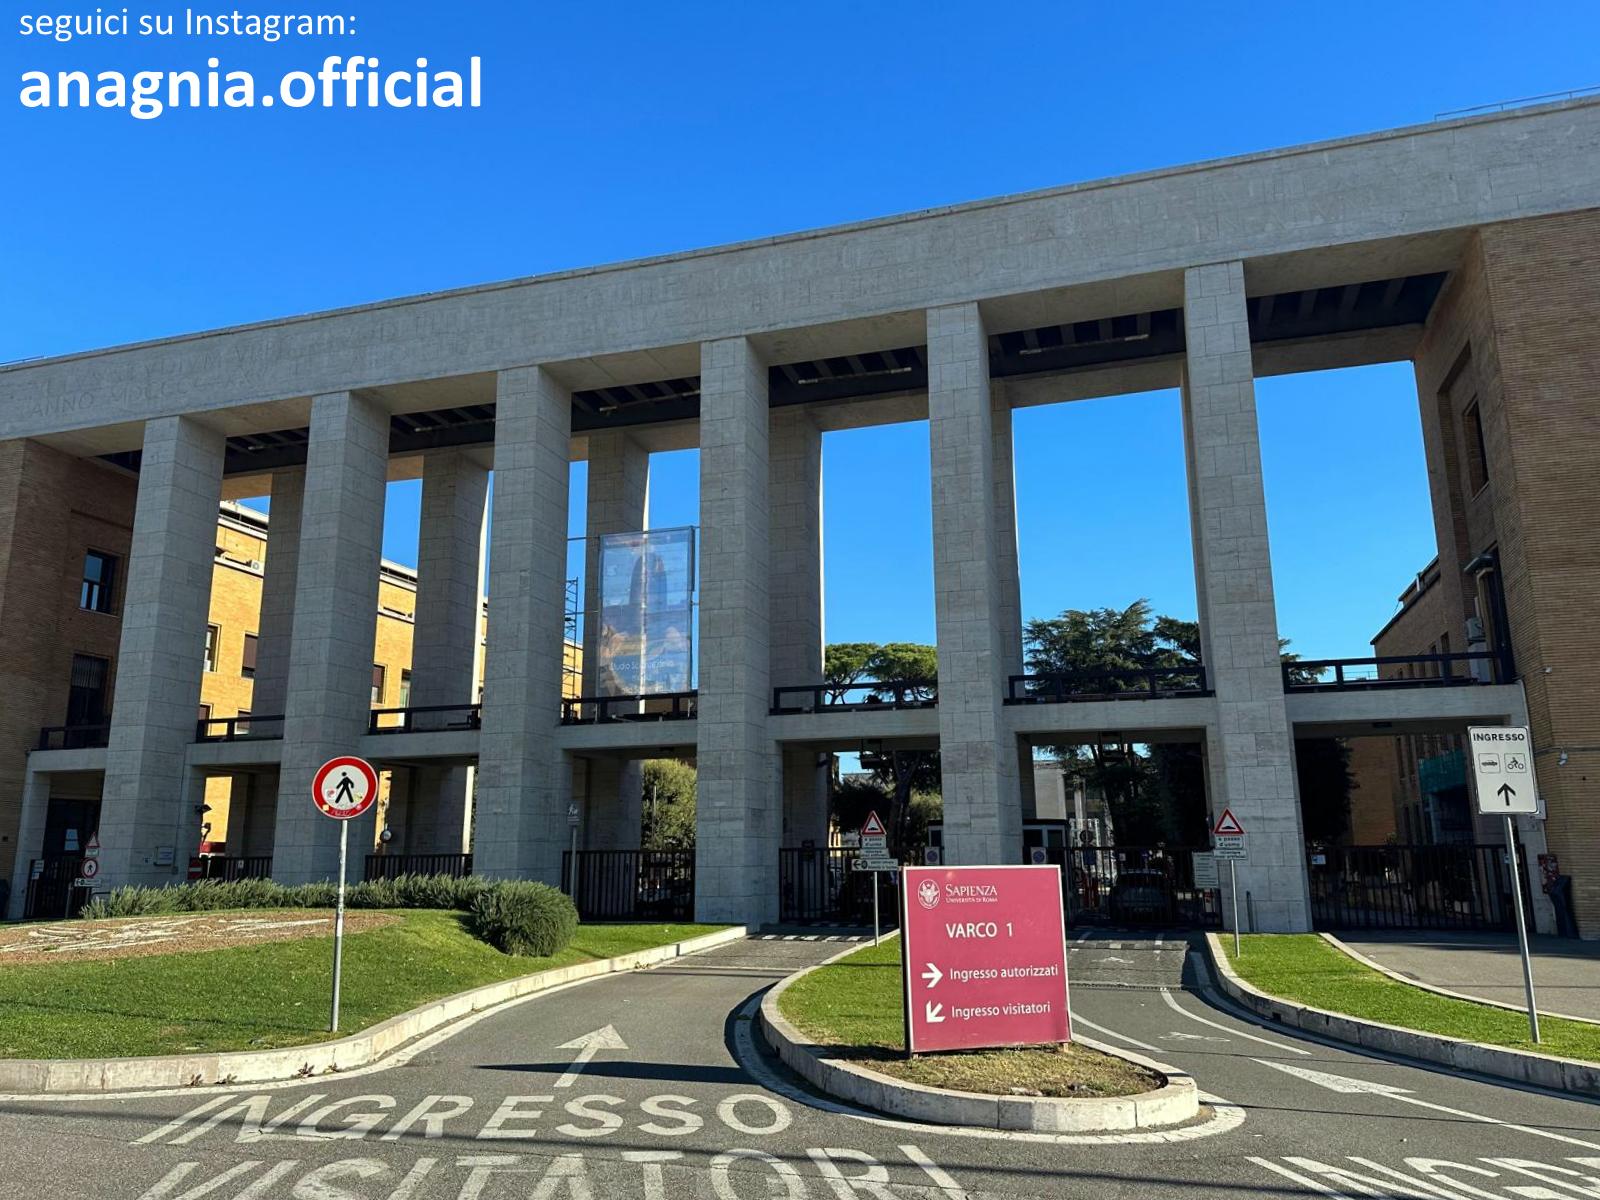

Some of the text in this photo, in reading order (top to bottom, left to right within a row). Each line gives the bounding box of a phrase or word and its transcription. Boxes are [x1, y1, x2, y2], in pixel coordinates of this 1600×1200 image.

[1473, 733, 1525, 741] INGRESSO
[945, 883, 998, 897] SAPIENZA
[946, 922, 1014, 938] VARCO 1
[950, 964, 1058, 982] Ingresso autorizzati
[951, 1001, 1051, 1020] Ingresso visitatori
[129, 1093, 793, 1144] INGRESSO
